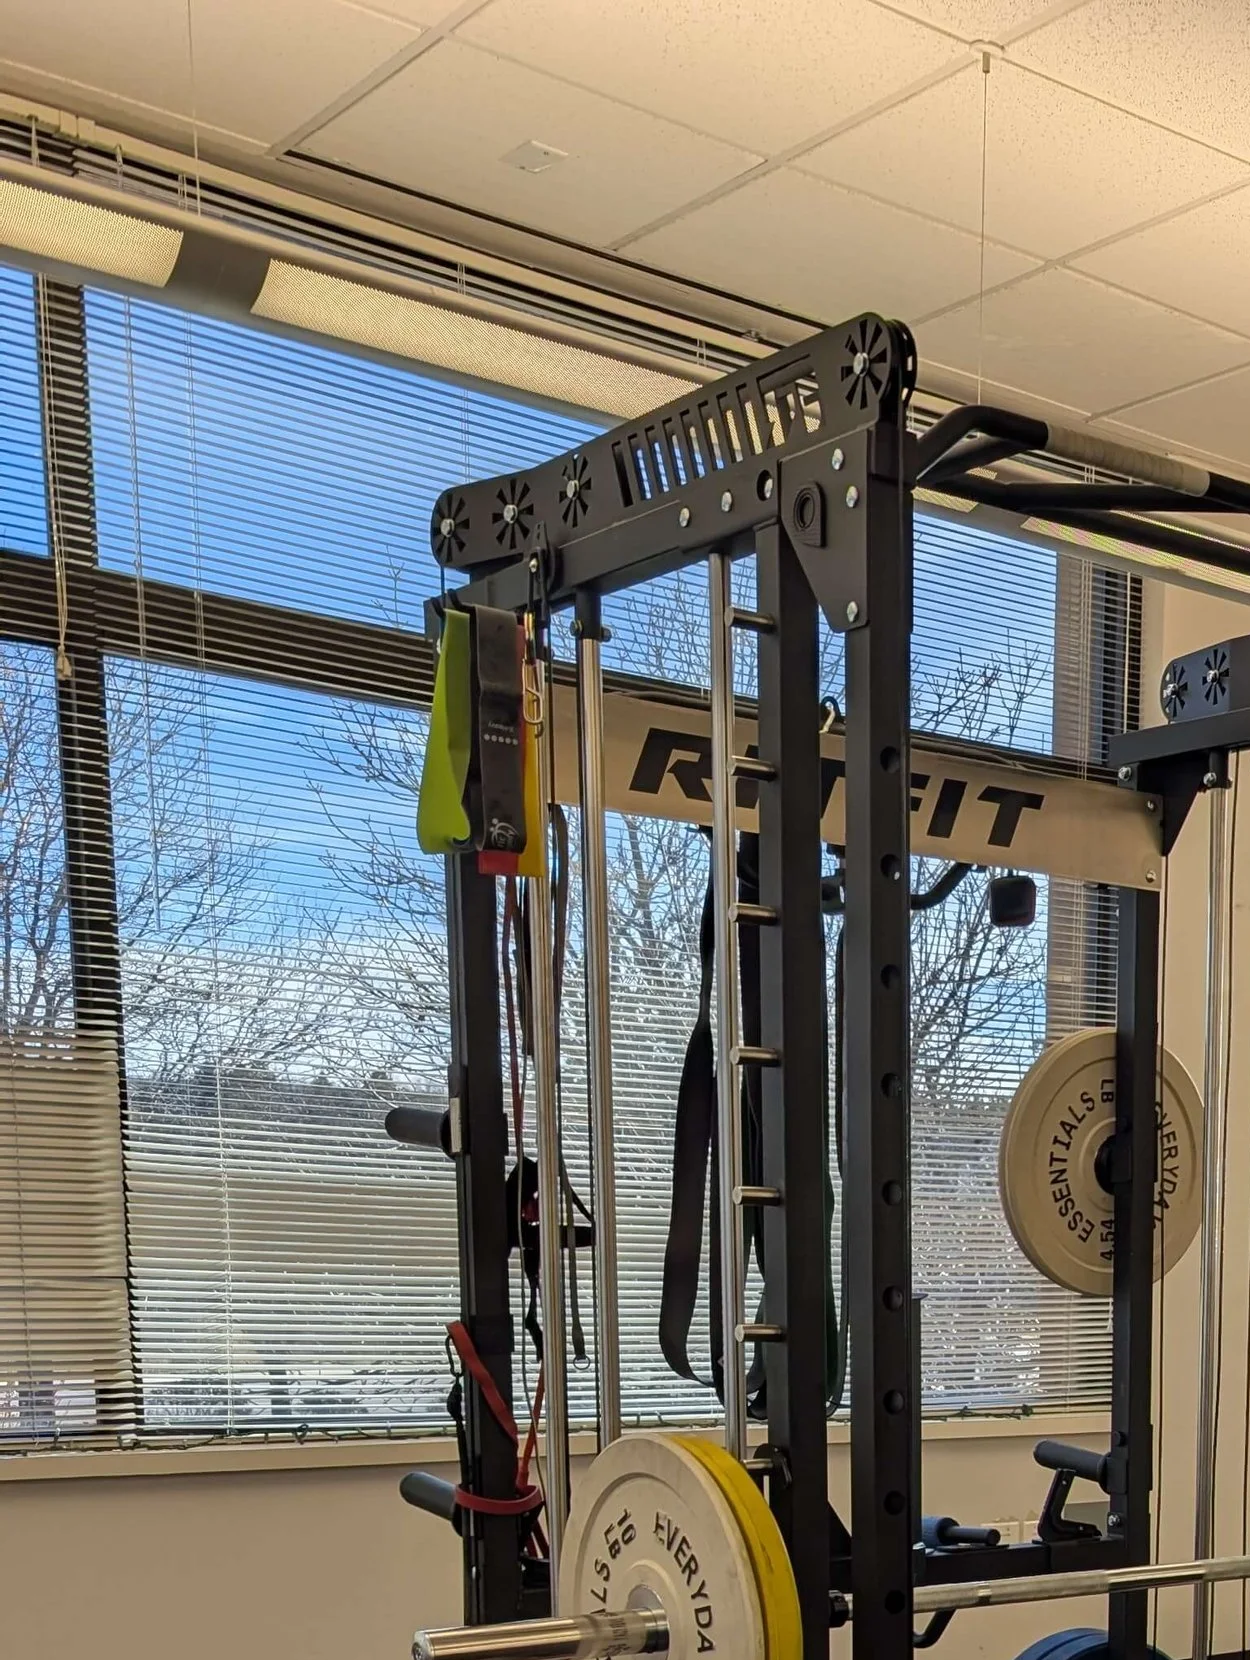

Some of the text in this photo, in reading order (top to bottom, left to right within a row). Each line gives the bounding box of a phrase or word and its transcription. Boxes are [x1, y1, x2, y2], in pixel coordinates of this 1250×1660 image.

[1049, 1090, 1096, 1243] ESSENTIALS
[604, 1525, 622, 1560] LB
[616, 1508, 637, 1546] 10
